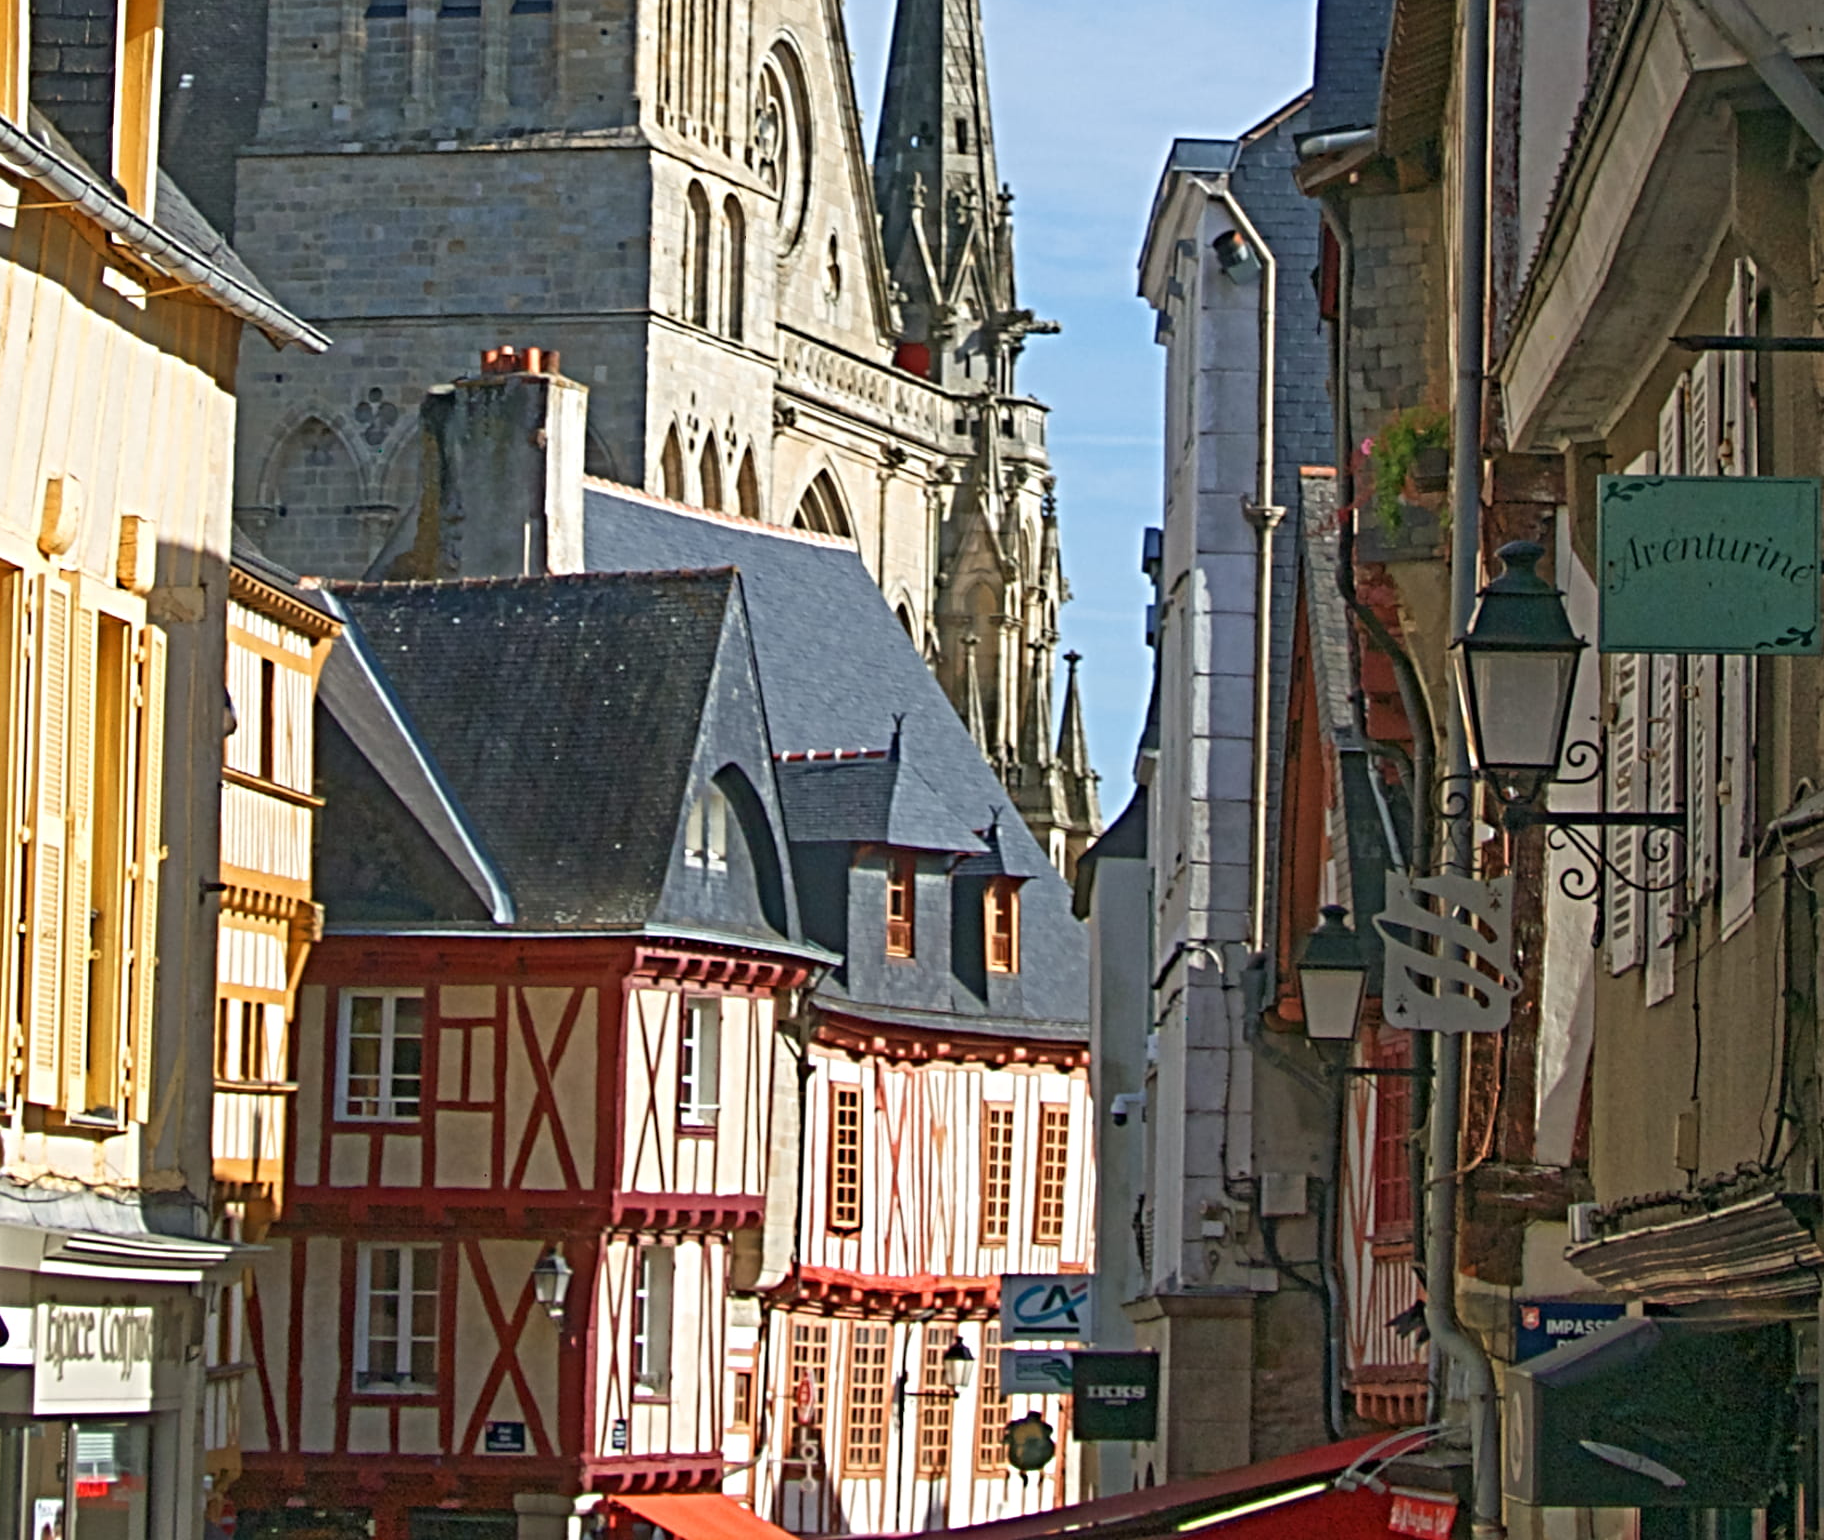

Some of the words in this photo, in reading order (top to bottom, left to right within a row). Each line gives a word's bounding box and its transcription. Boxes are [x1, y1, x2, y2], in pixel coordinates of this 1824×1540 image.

[1606, 531, 1816, 596] Aventurine
[1546, 1318, 1613, 1335] IMPASS
[1087, 1385, 1147, 1399] IKKS
